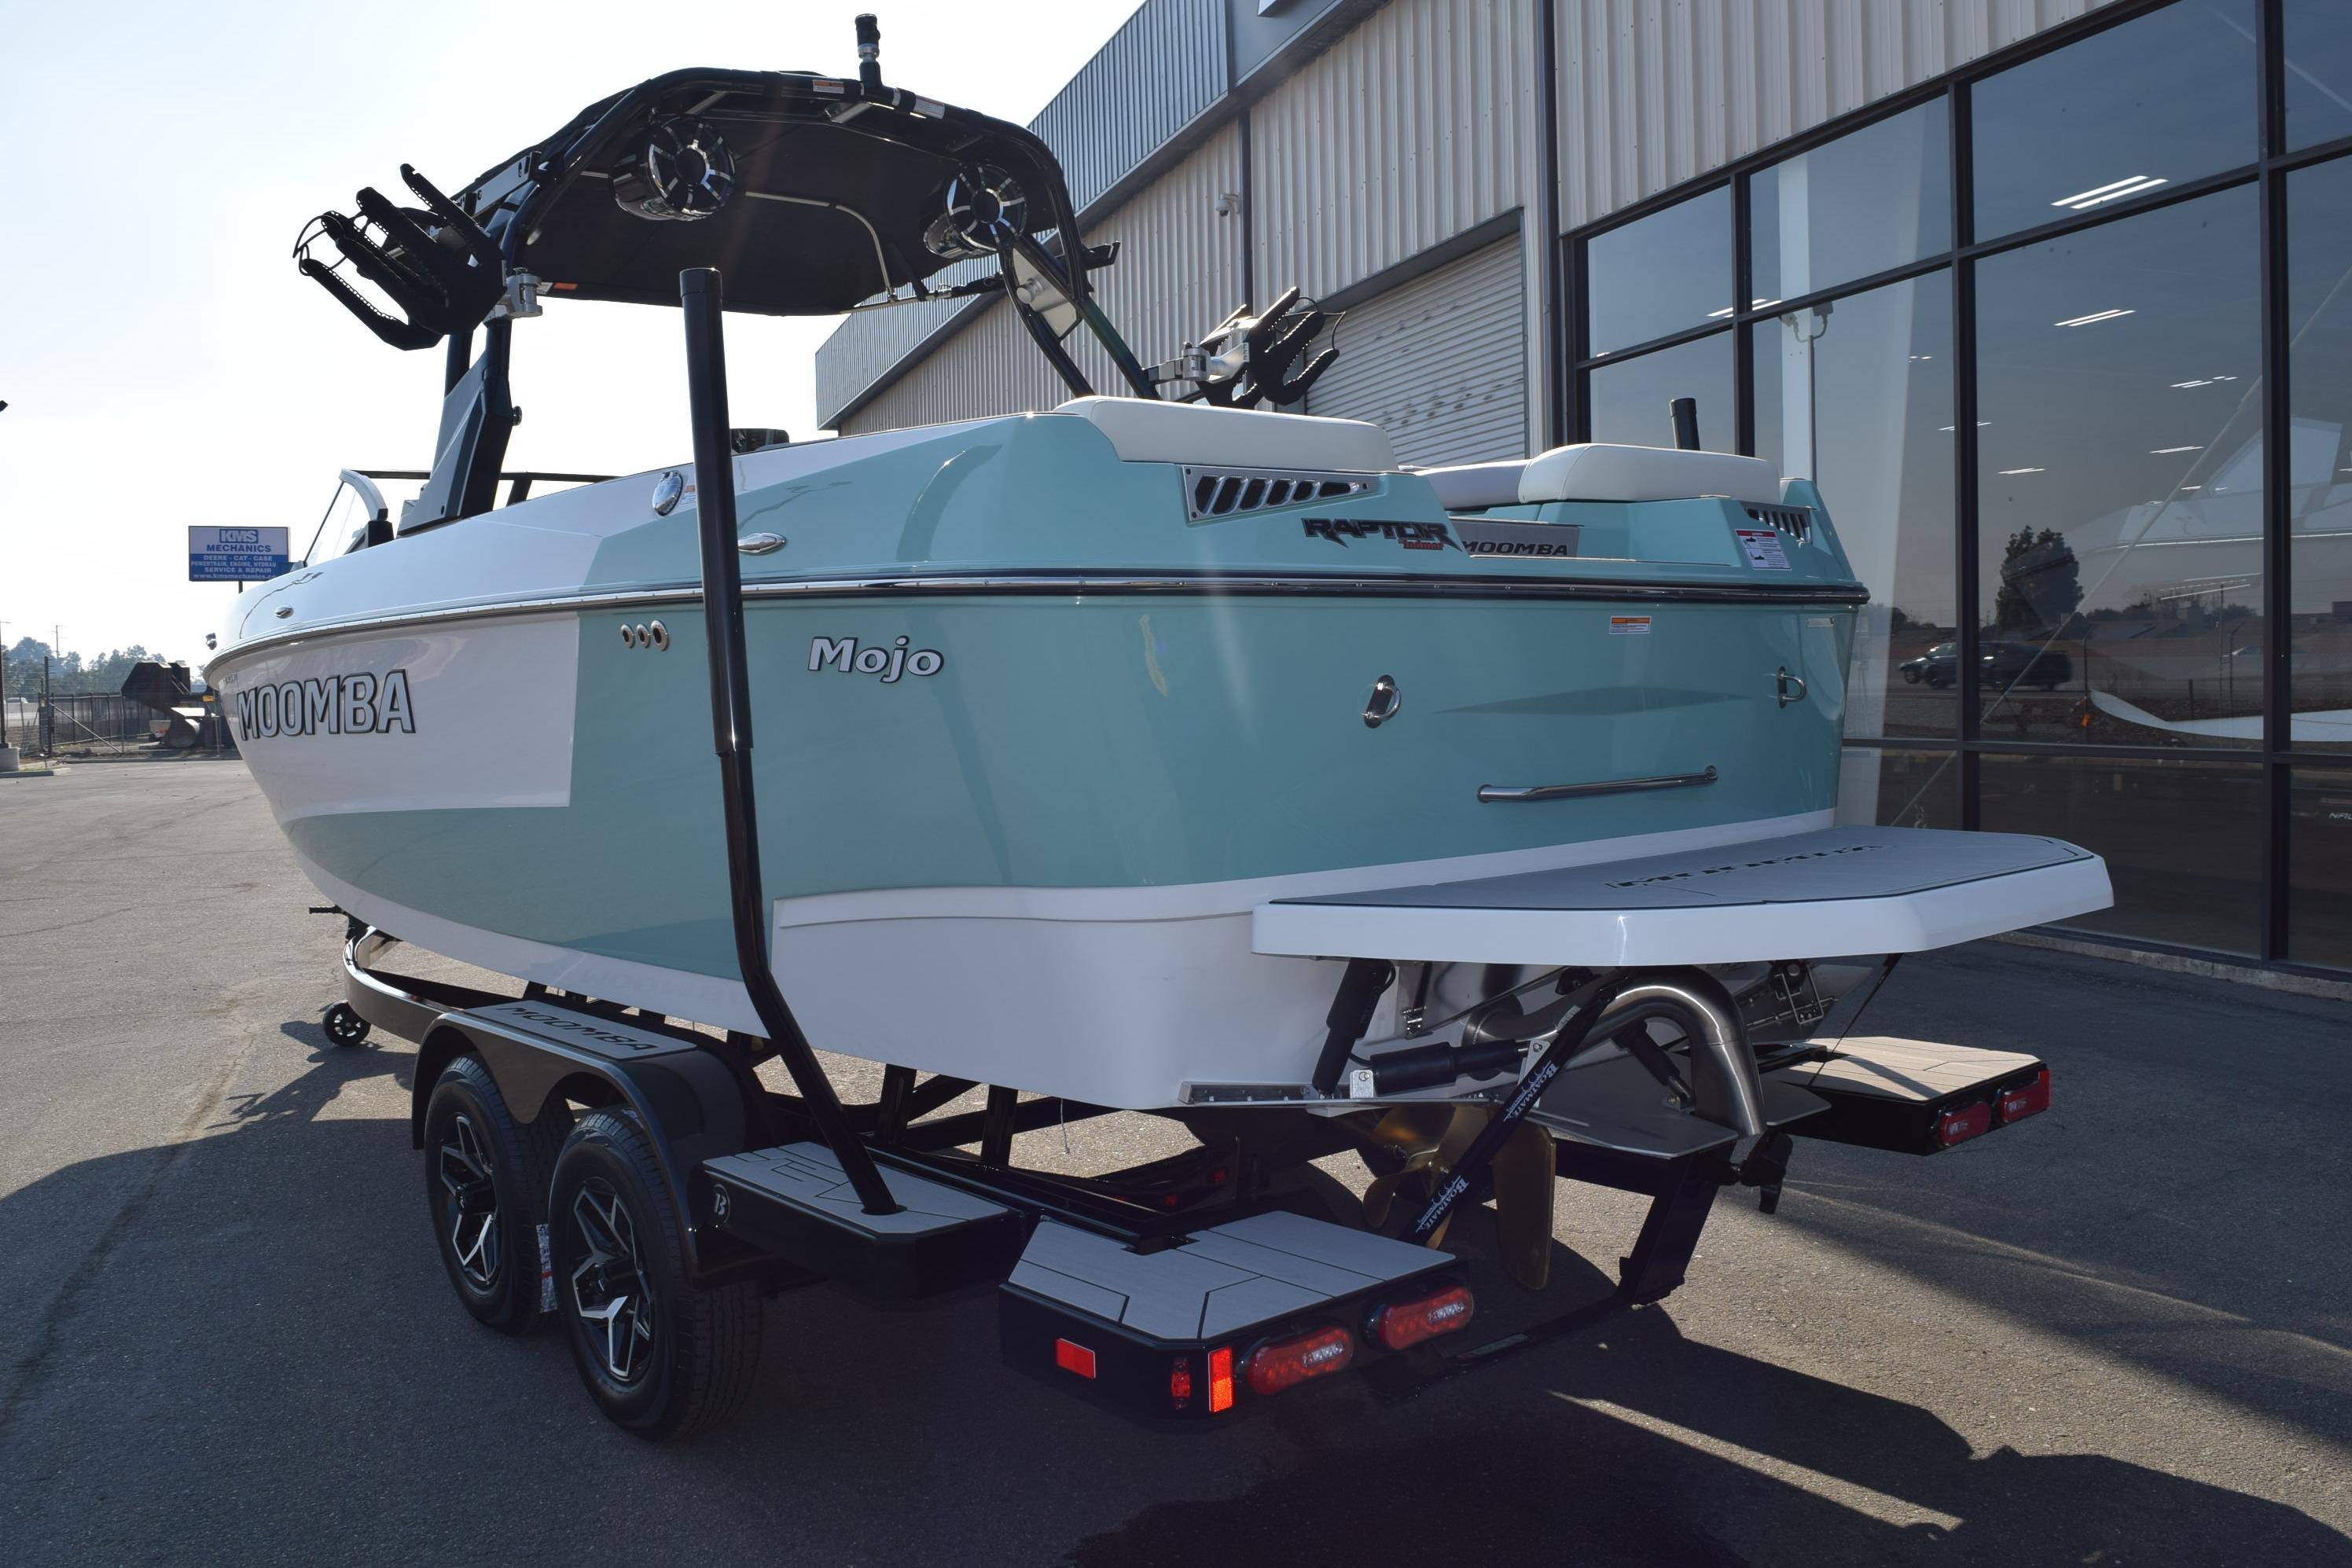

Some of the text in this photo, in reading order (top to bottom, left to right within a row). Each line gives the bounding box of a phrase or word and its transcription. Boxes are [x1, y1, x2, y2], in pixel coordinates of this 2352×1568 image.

[221, 531, 258, 542] KMS
[1301, 517, 1463, 552] RAPTOR
[1461, 541, 1567, 556] MOOMBA
[807, 635, 944, 684] Mojo
[237, 669, 416, 741] MOOMBA
[497, 1007, 660, 1052] MOOMBA
